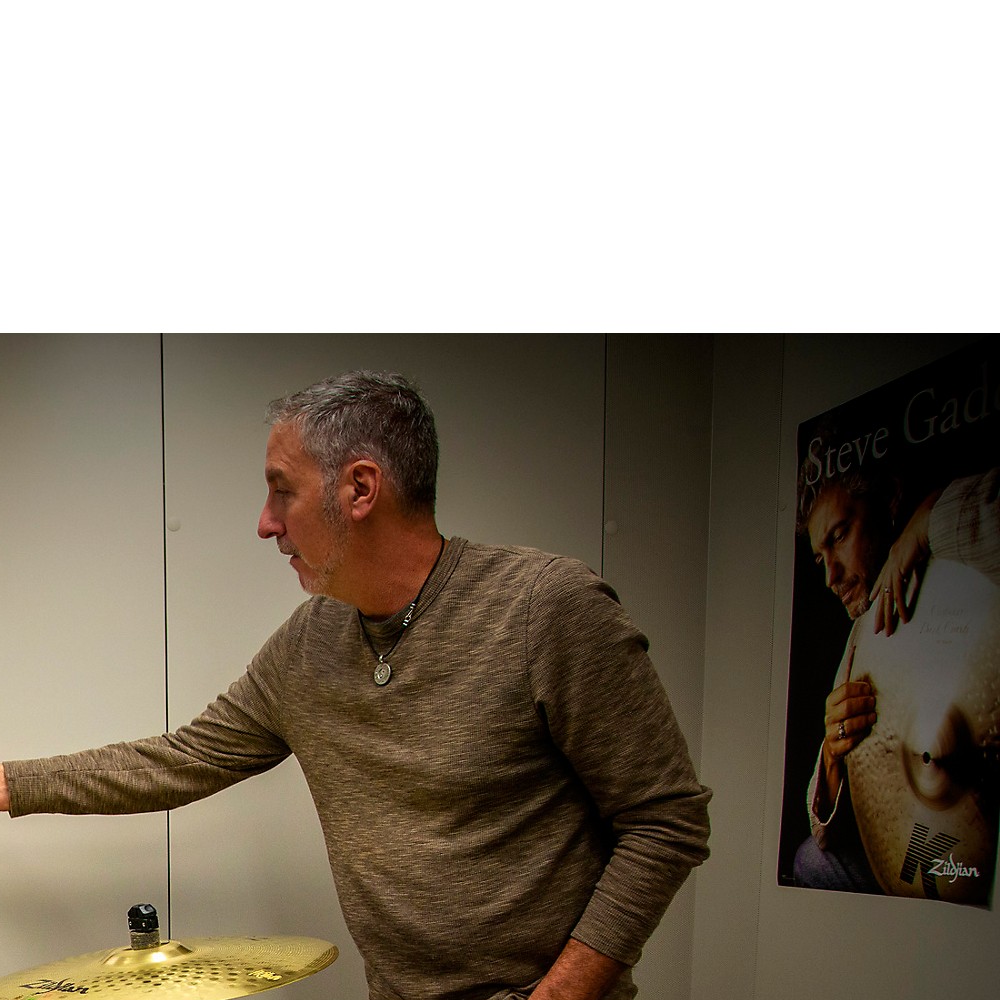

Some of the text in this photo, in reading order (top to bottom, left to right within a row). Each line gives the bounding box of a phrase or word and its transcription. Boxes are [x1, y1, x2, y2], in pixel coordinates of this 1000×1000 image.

[805, 426, 889, 486] Steve
[900, 822, 960, 899] K
[928, 852, 980, 883] Zildjian
[18, 978, 89, 996] Zildjian
